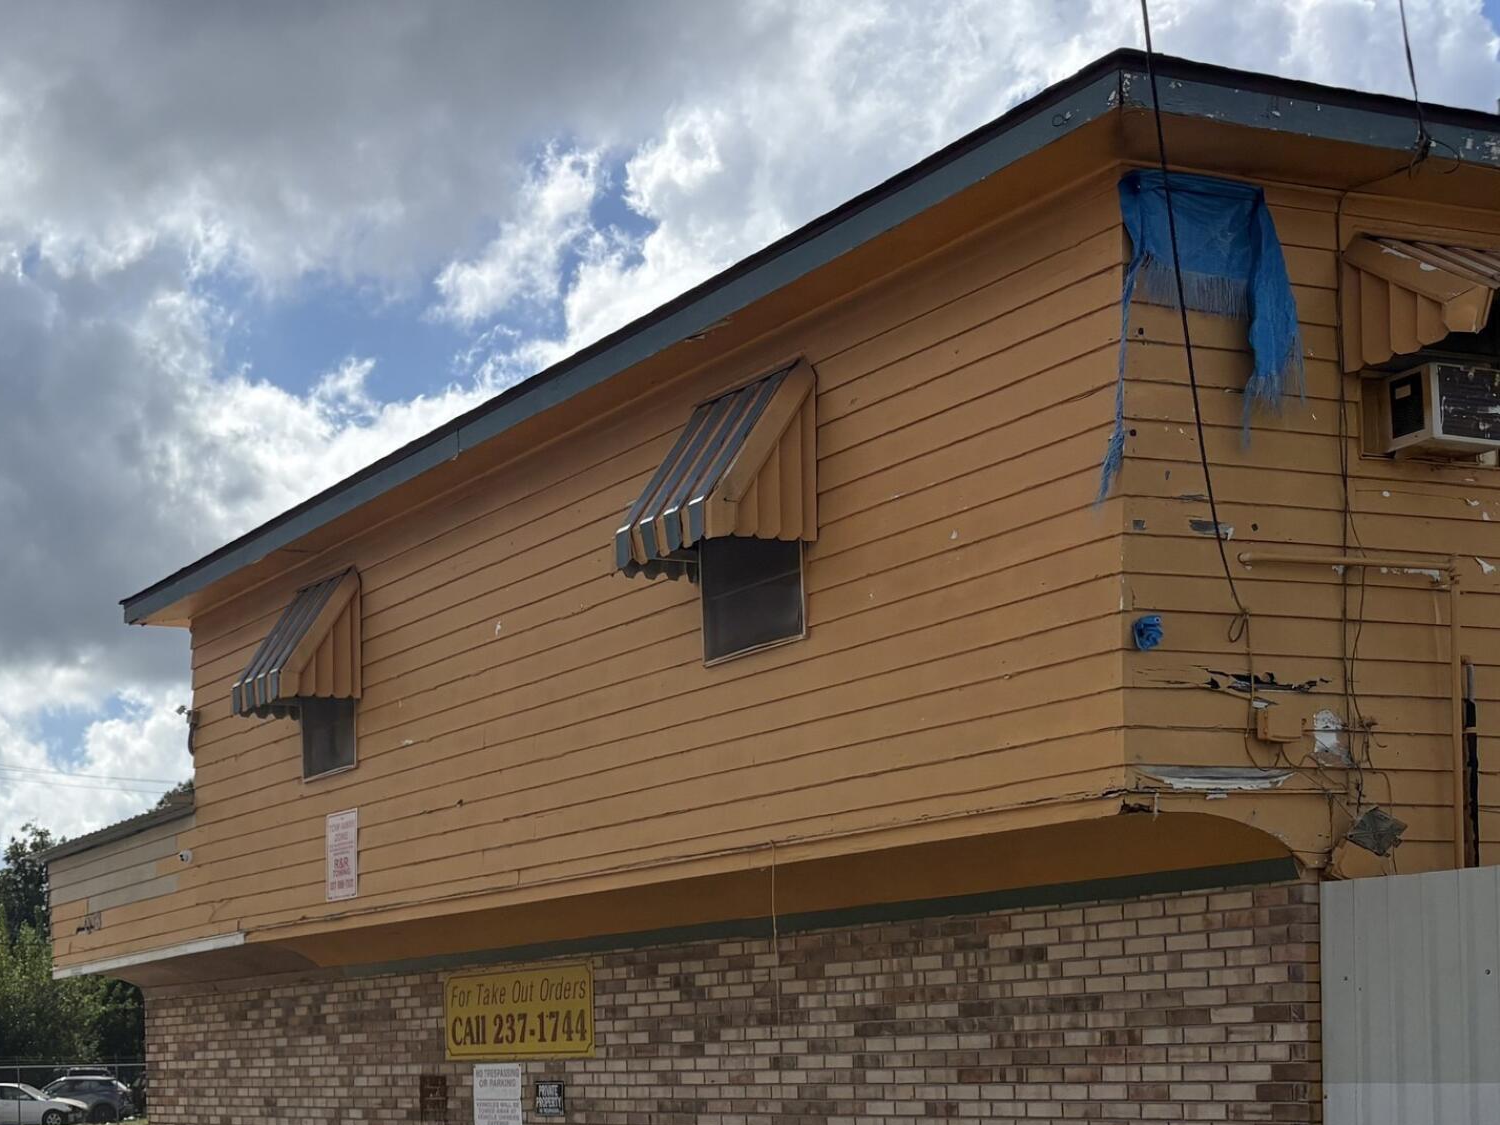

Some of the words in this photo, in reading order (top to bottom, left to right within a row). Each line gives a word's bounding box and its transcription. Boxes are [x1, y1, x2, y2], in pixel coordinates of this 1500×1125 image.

[334, 857, 349, 869] R&R
[451, 986, 472, 1009] For
[476, 983, 506, 1006] Take
[511, 979, 534, 1004] Out
[540, 976, 586, 1002] Orders
[479, 1079, 488, 1088] OR
[489, 1078, 516, 1088] PARKING
[538, 1085, 558, 1097] PRIVATE
[536, 1096, 561, 1107] PROPERTY
